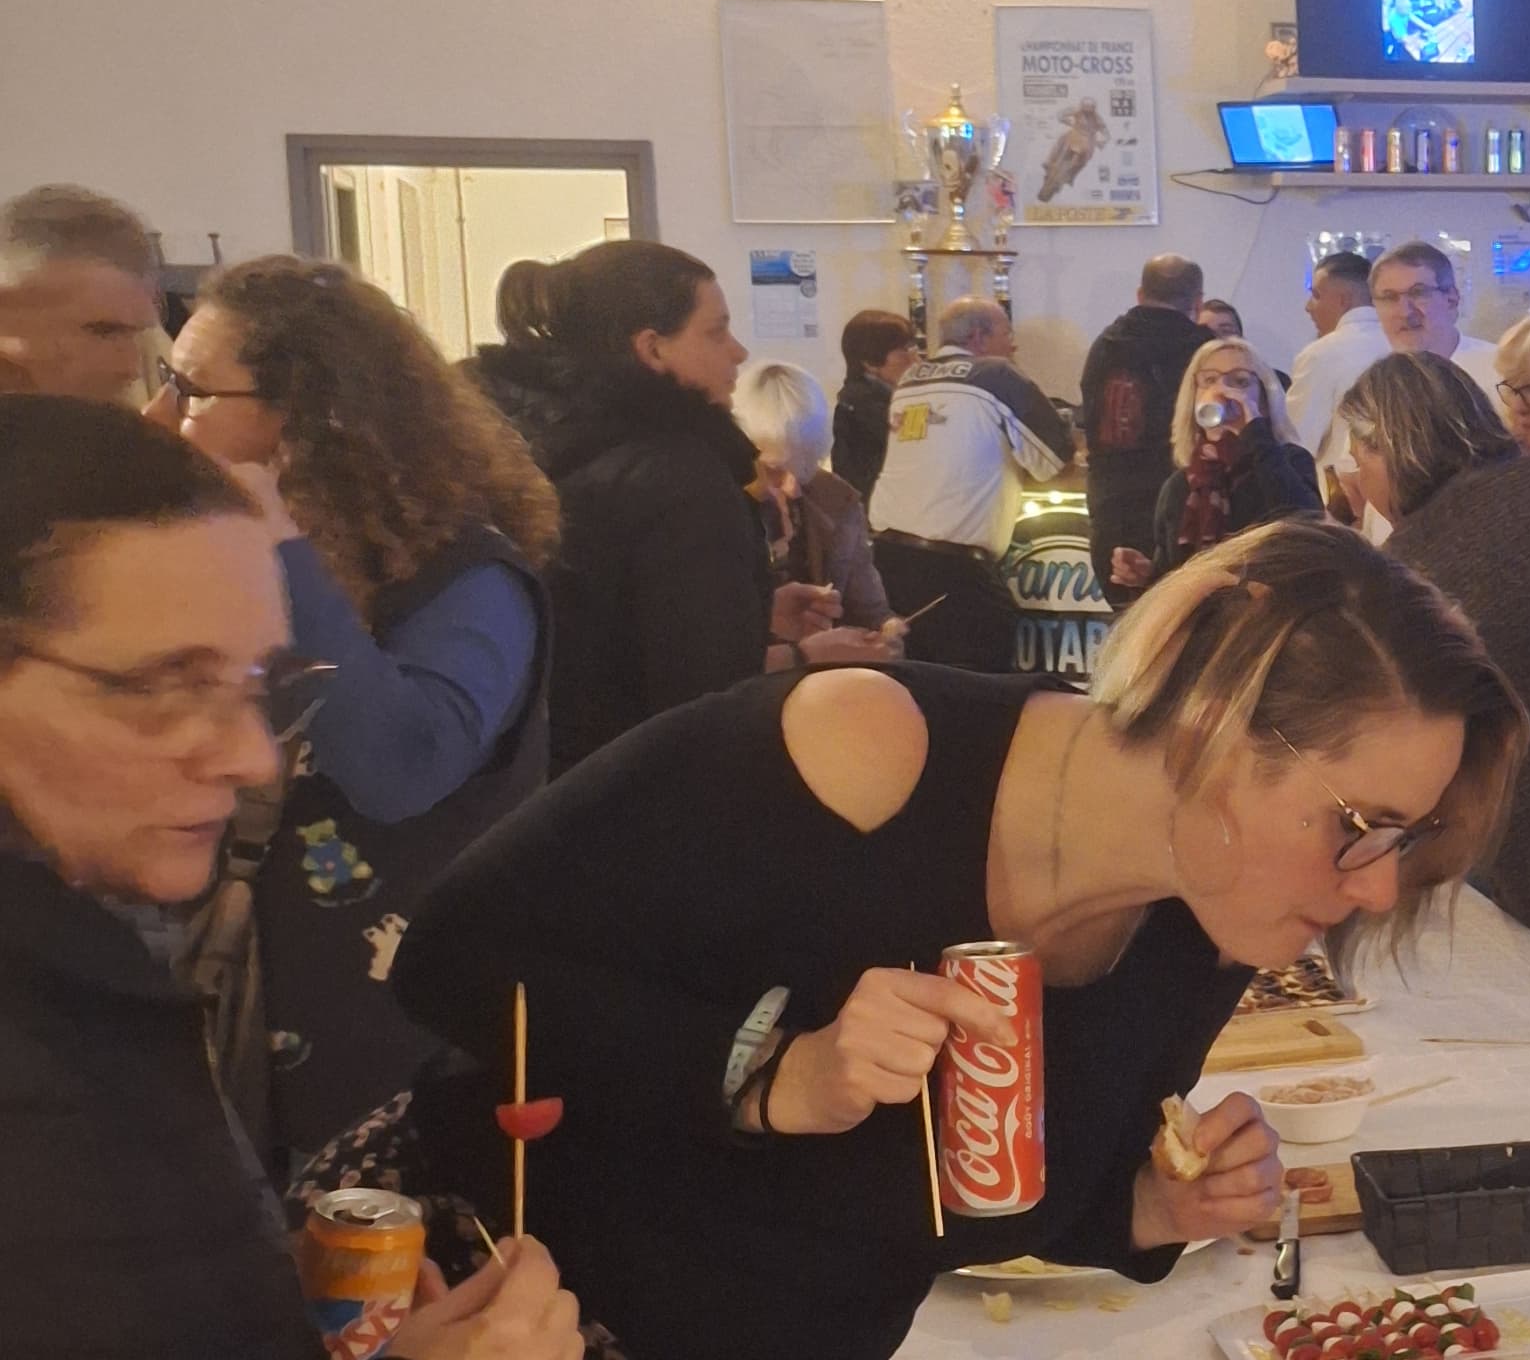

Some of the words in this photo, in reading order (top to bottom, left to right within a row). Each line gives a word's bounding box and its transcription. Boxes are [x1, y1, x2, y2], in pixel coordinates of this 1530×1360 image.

[1101, 41, 1134, 53] FRANCE
[1022, 55, 1134, 74] MOTO-CROSS
[1055, 207, 1107, 222] POSTE
[1024, 1046, 1033, 1101] ORIGINAL
